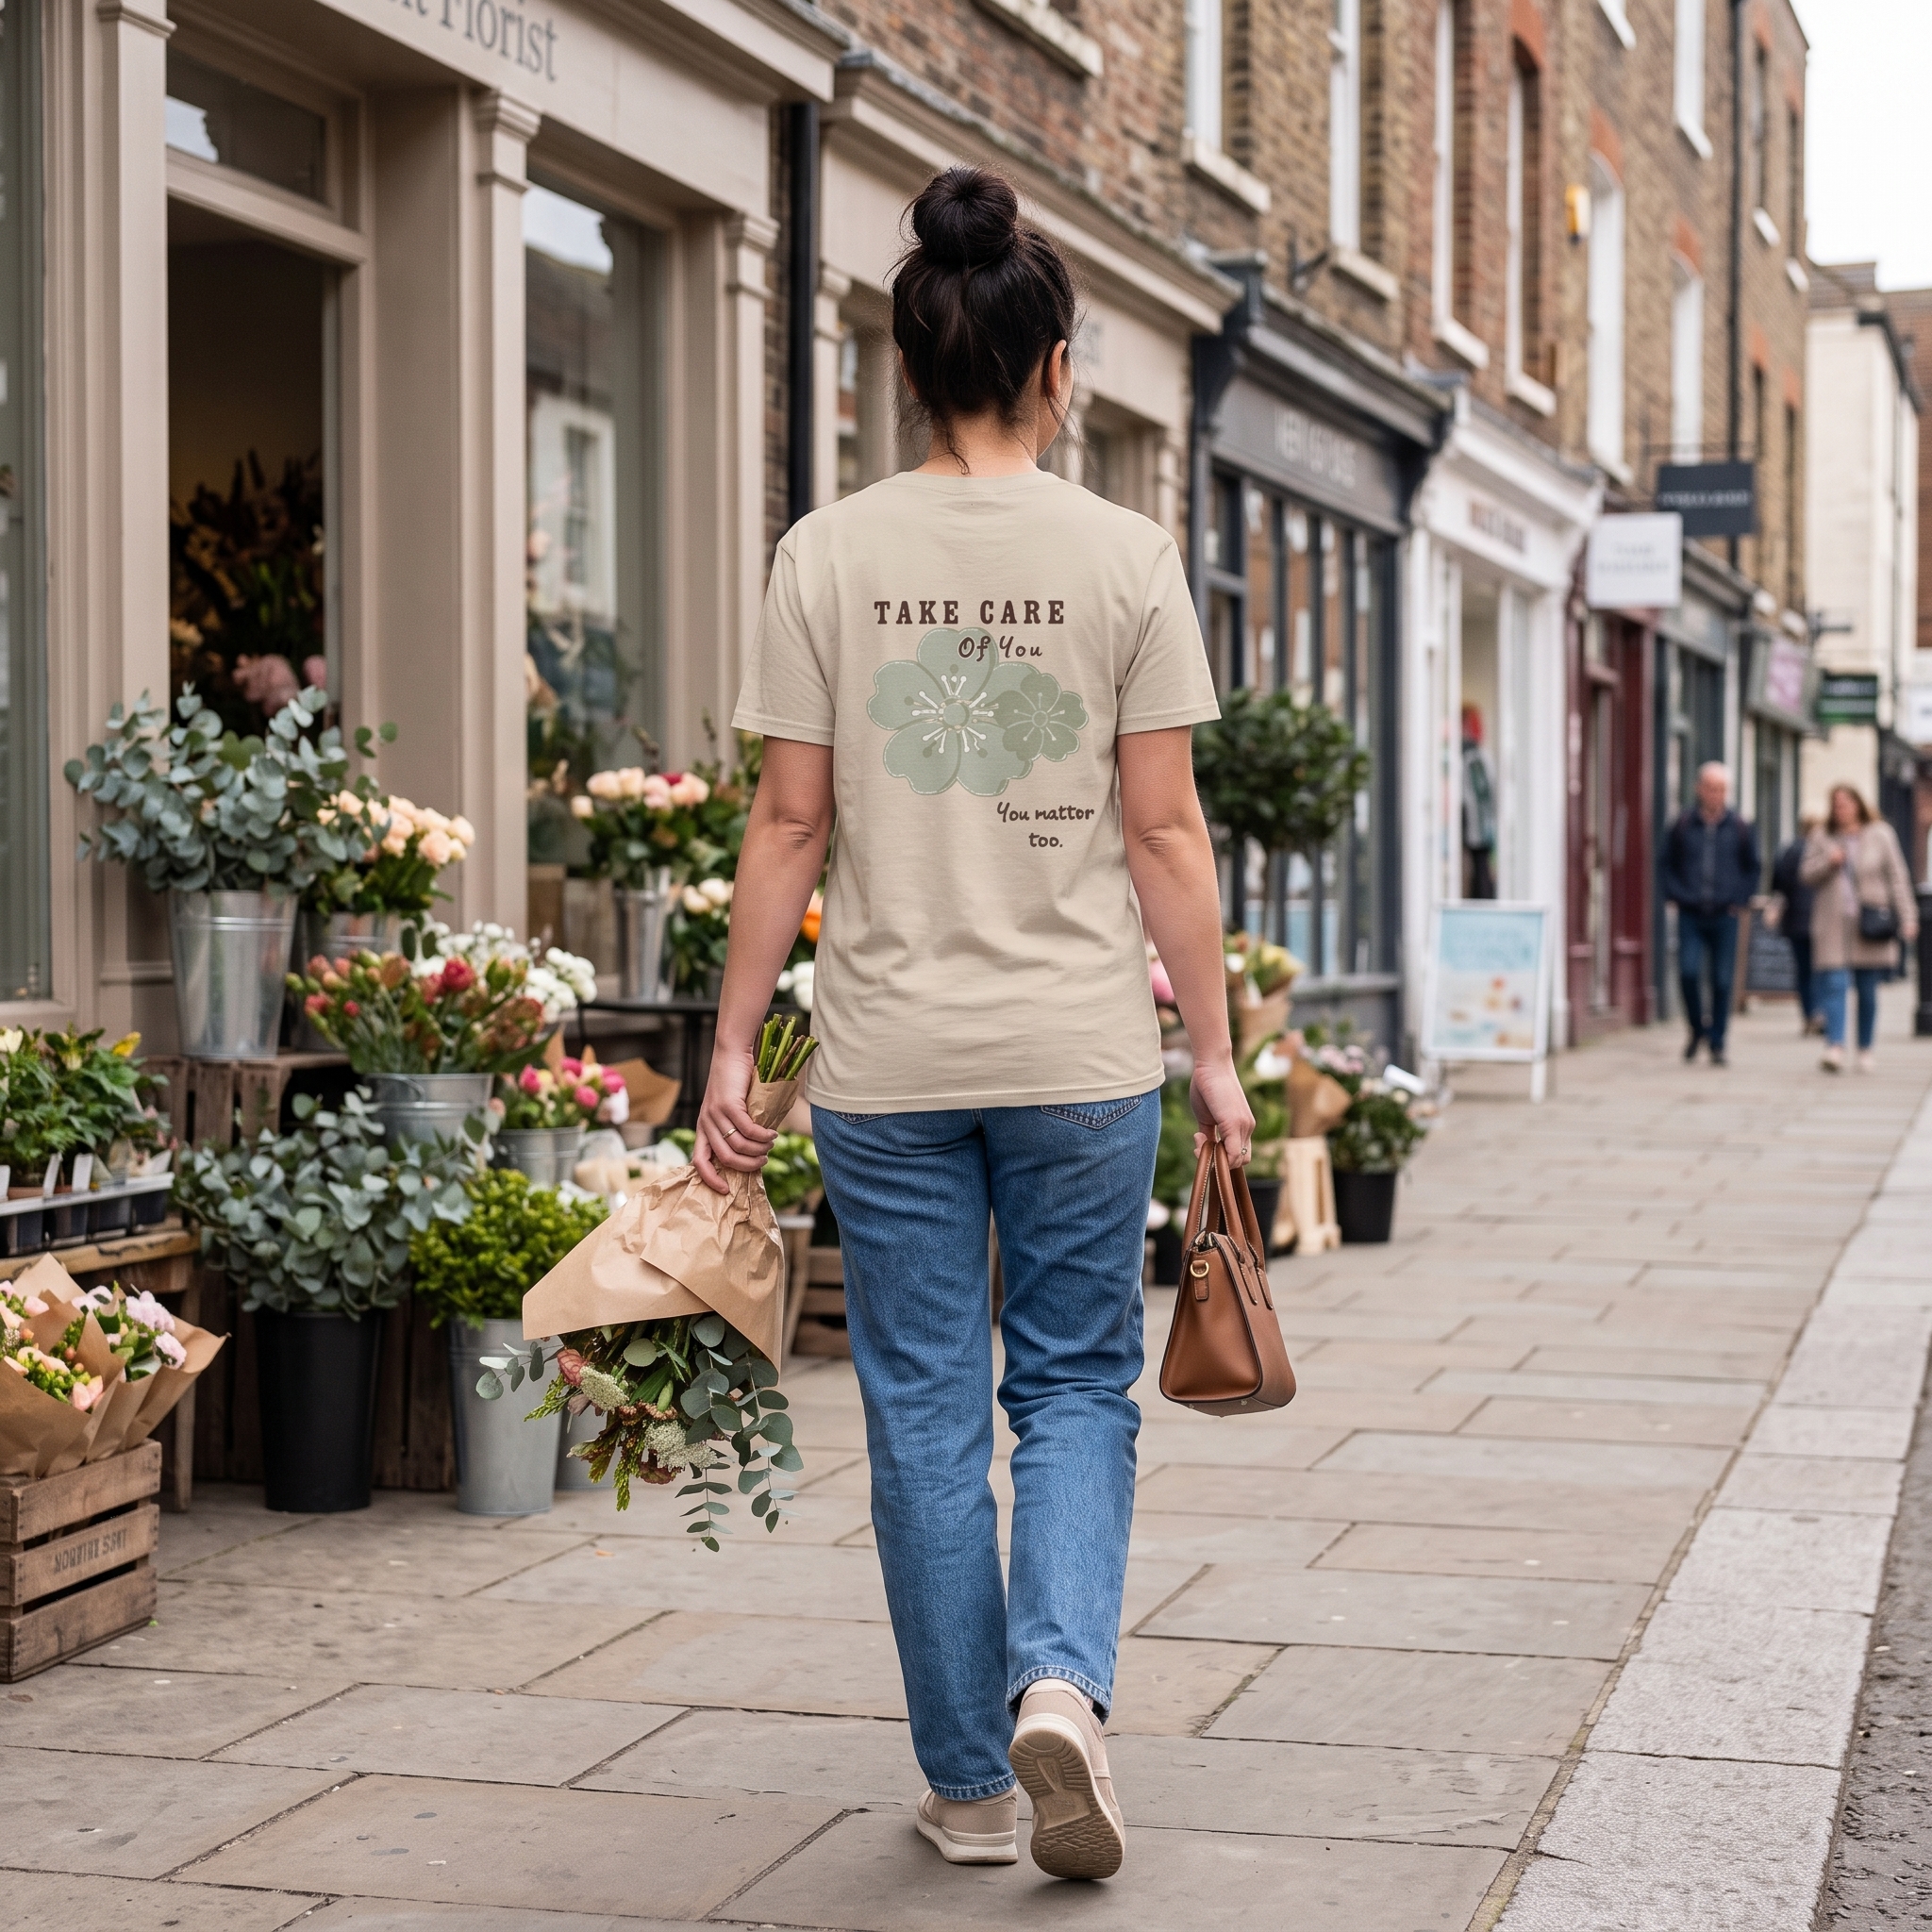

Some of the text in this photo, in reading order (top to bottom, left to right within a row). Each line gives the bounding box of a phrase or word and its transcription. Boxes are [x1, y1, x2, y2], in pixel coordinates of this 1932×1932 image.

[874, 600, 1064, 625] TAKE CARE
[958, 635, 1042, 662] Of You
[996, 801, 1030, 823] You
[1028, 832, 1063, 848] too.
